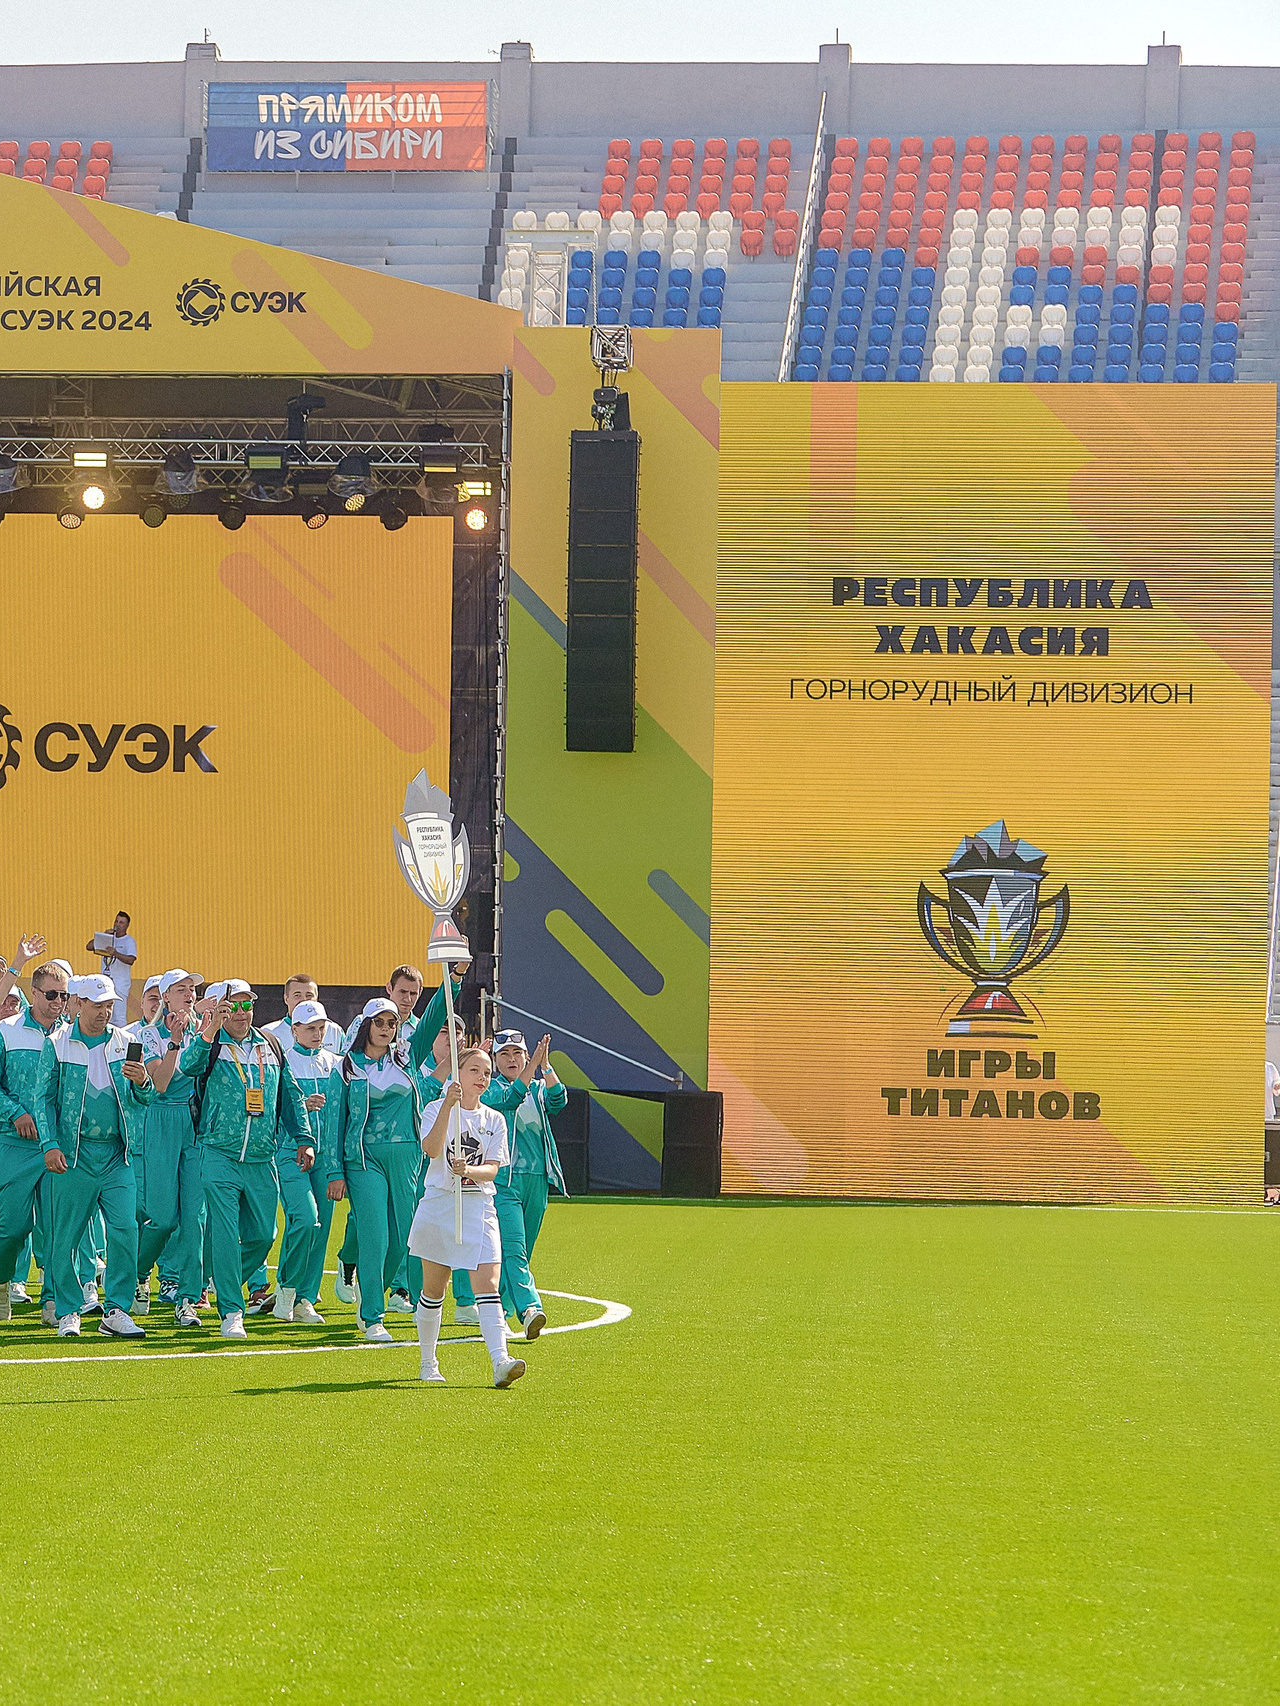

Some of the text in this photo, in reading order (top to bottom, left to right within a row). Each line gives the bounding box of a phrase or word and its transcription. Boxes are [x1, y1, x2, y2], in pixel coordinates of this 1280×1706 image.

[257, 92, 444, 124] ПРЯМИКОМ
[253, 128, 444, 160] ИЗ СИБИРИ
[230, 291, 307, 313] СУЭК
[0, 309, 75, 332] СУЭК
[81, 309, 153, 331] 2024
[832, 577, 1154, 609] РЕСПУБЛИКА
[874, 625, 1110, 656] ХАКАСИЯ
[789, 674, 1193, 707] ГОРНОРУДНЫЙ ДИВИЗИОН
[33, 722, 219, 773] СУЭК
[926, 1049, 1056, 1080] ИГРЫ
[880, 1087, 1102, 1120] ТИТАНОВ
